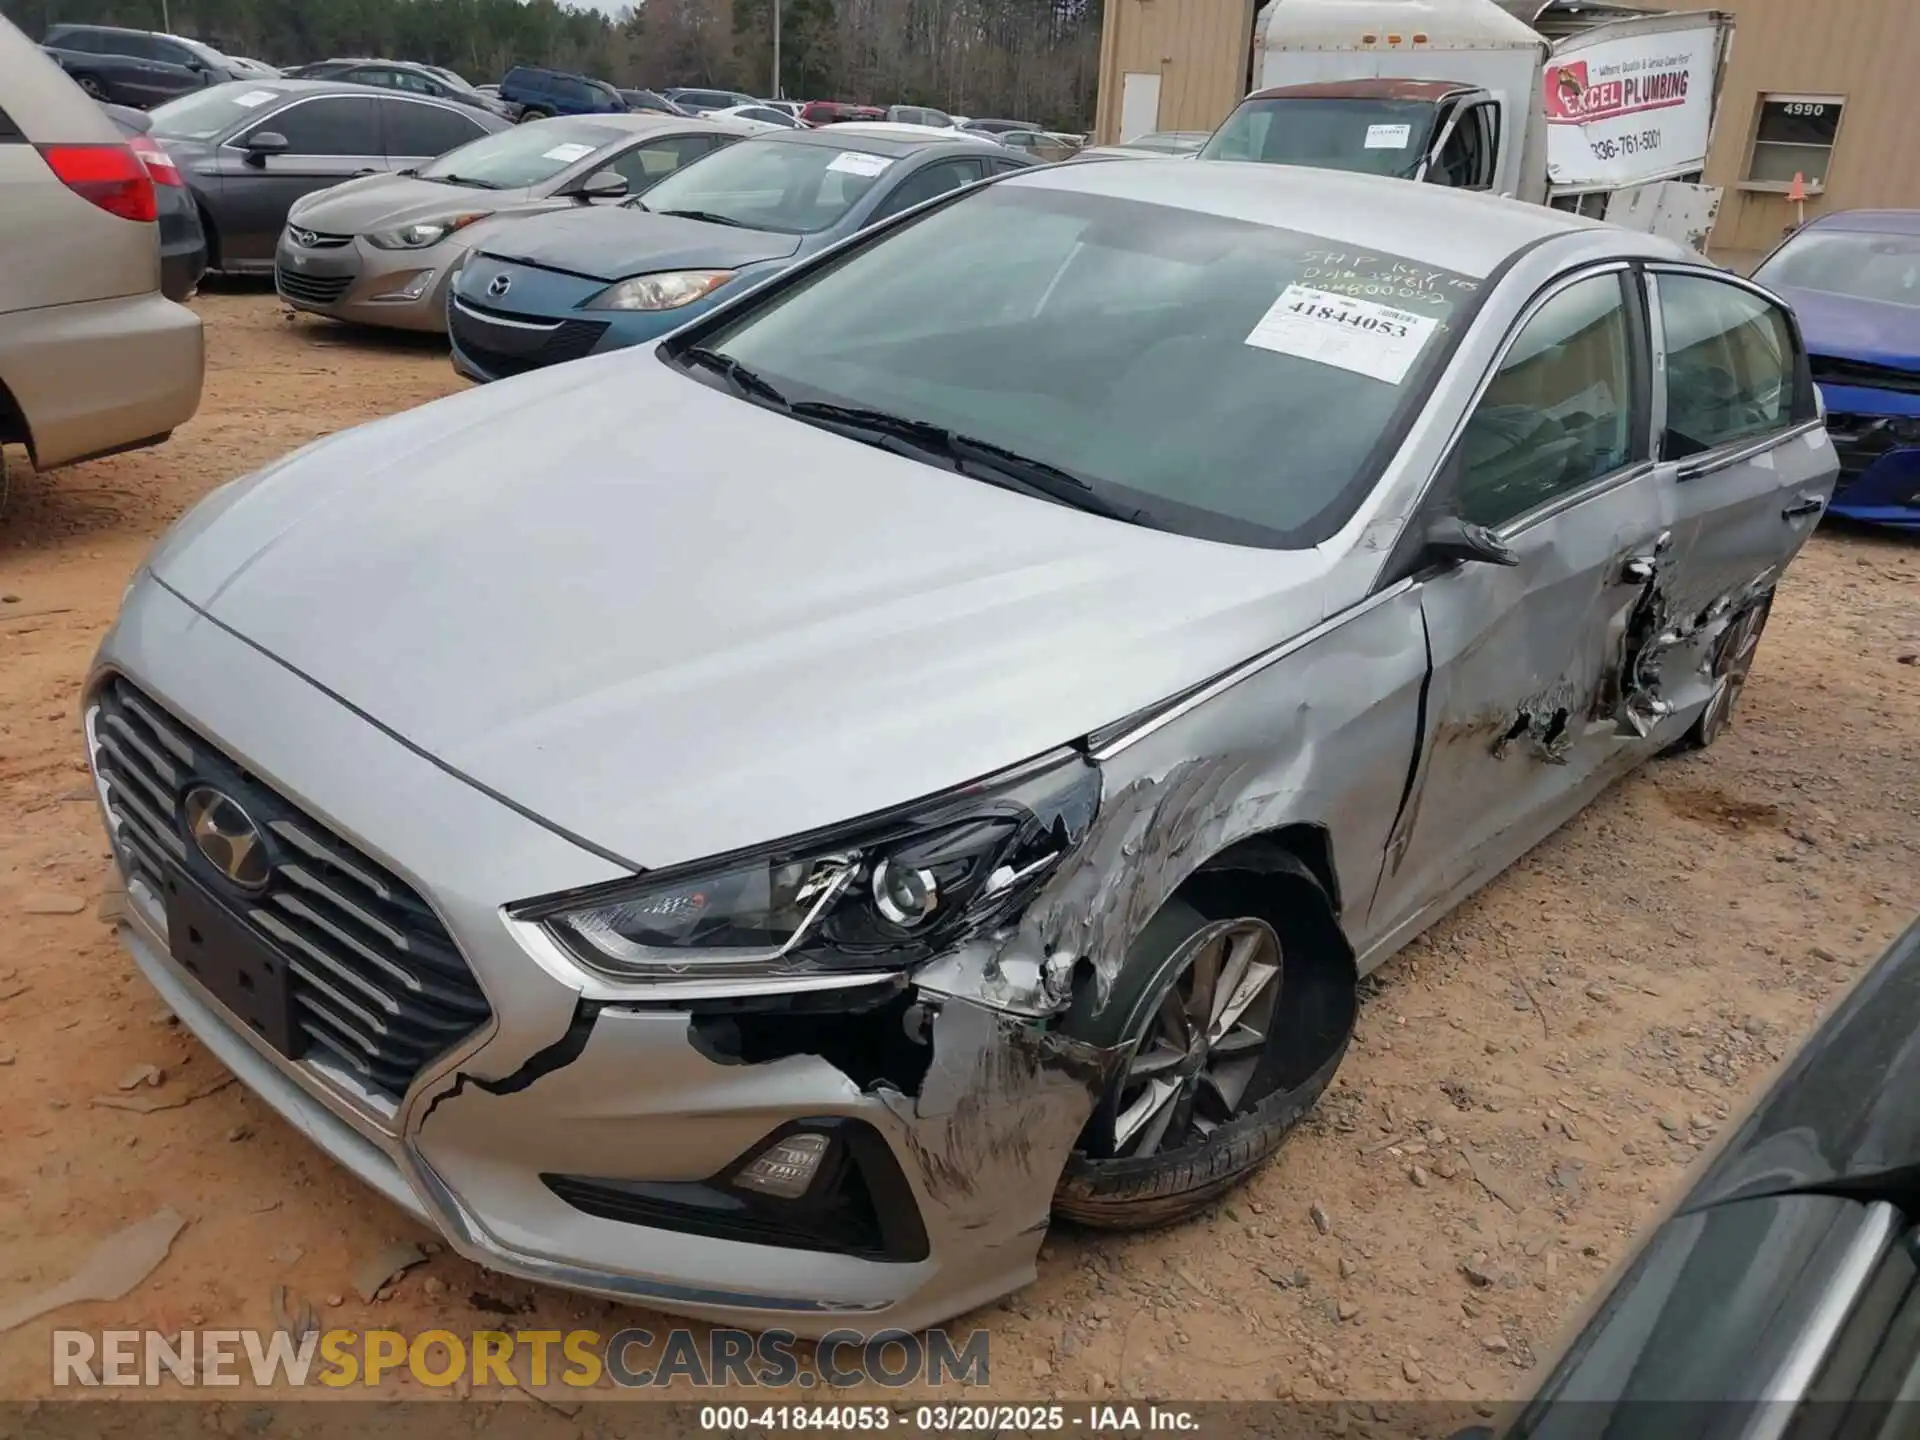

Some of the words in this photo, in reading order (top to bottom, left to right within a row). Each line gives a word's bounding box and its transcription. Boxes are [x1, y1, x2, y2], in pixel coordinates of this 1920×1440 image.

[1564, 83, 1618, 114] EXCEL
[1624, 70, 1689, 106] PLUMBING
[1783, 103, 1824, 117] 4990
[1590, 128, 1662, 161] 336-761-5001
[1288, 301, 1408, 339] 41844053
